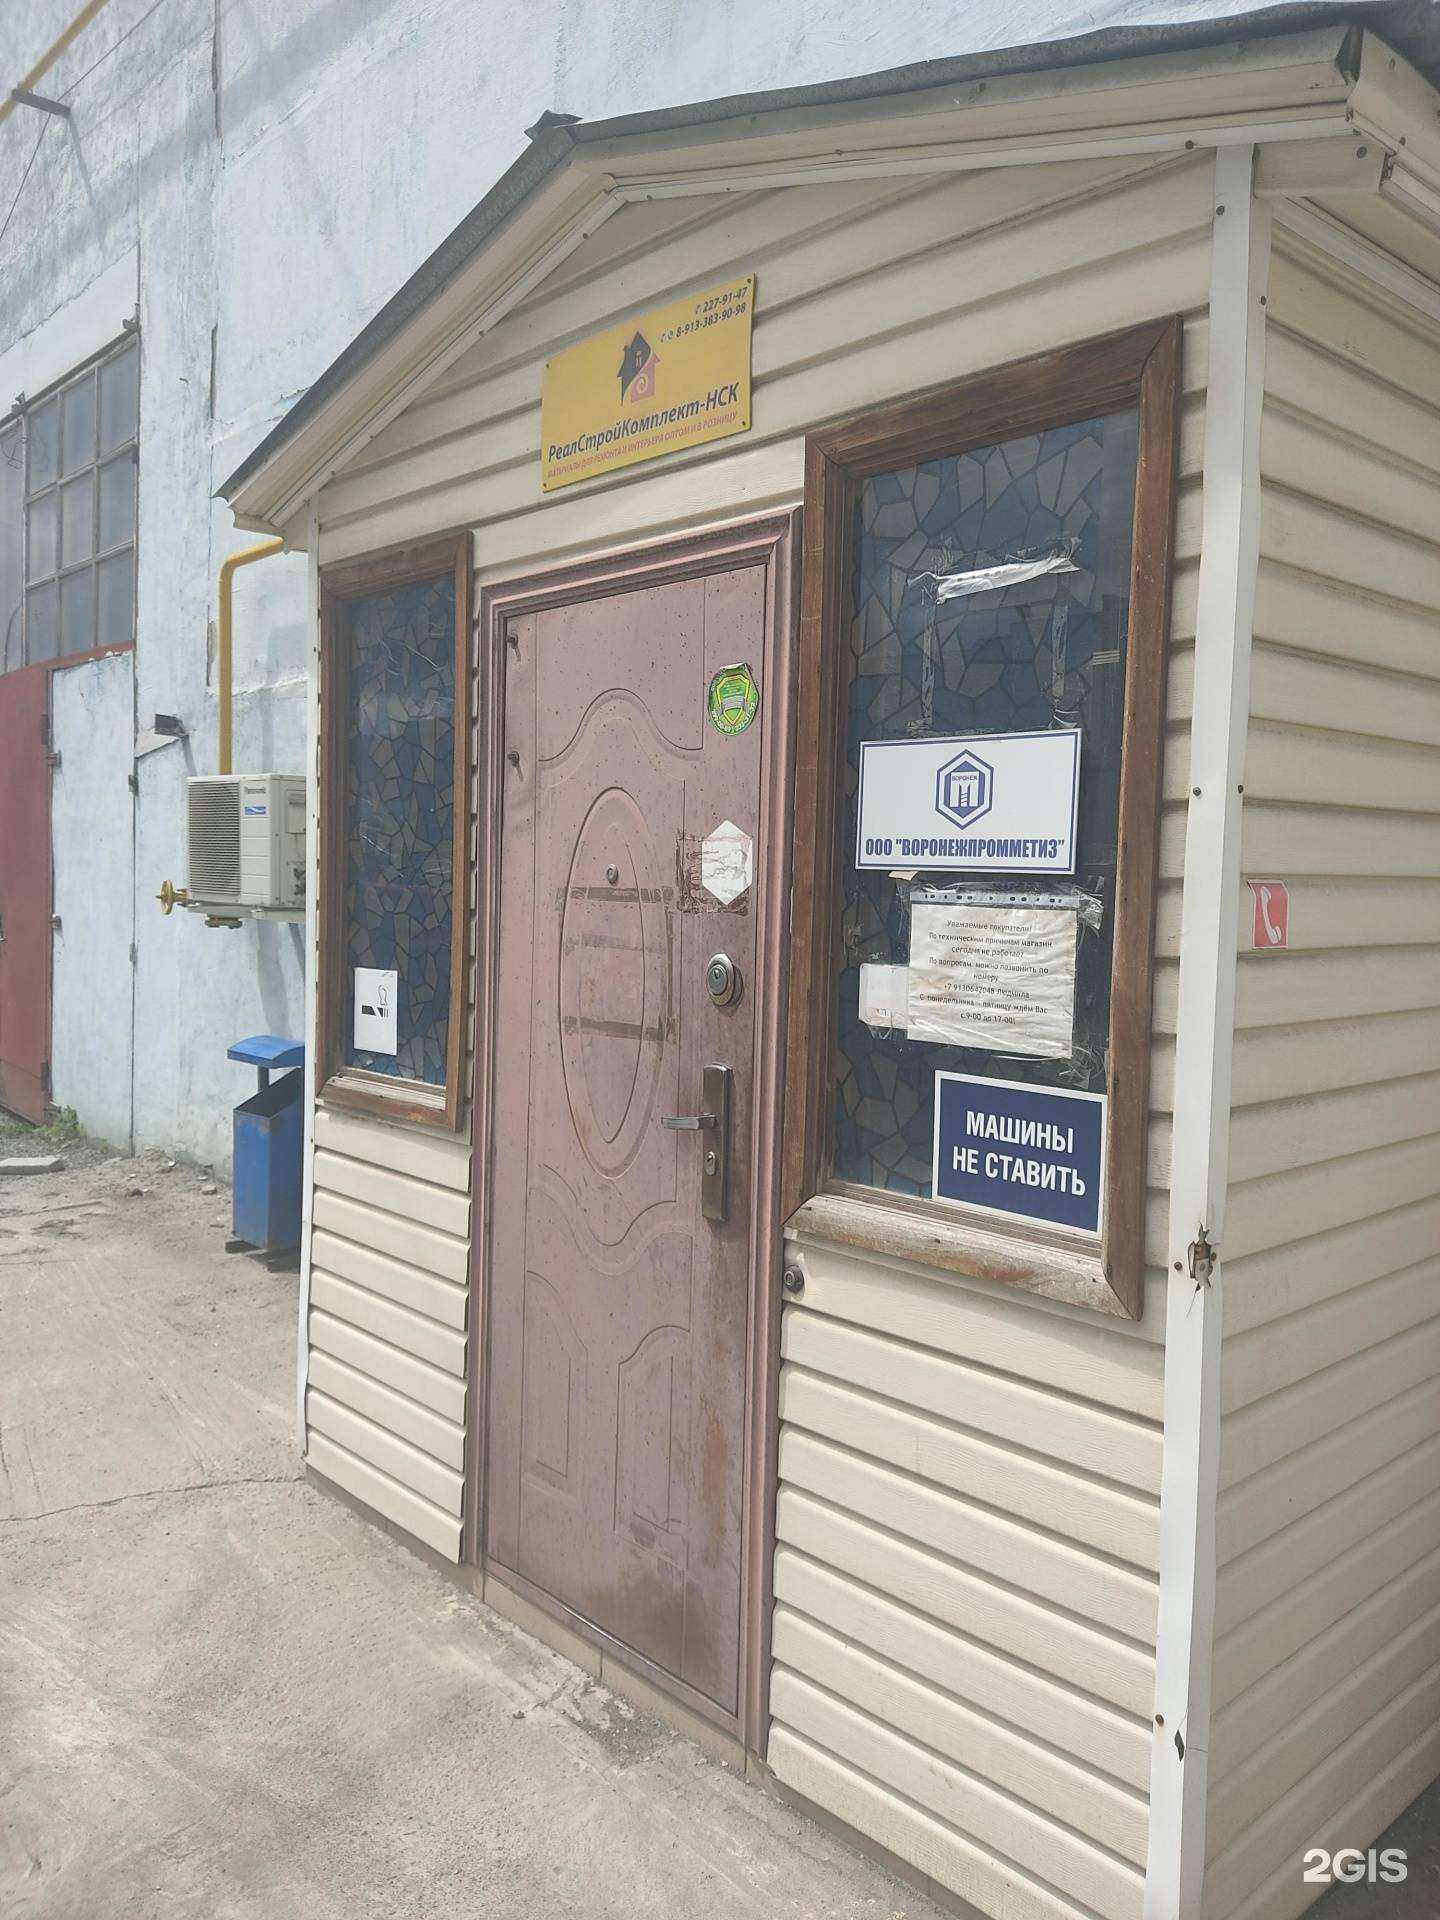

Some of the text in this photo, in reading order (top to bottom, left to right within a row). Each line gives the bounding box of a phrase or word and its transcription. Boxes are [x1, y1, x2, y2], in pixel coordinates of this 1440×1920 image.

[702, 286, 748, 313] 227-91-47
[548, 382, 740, 463] РеалСтройКомплект-НСК
[664, 425, 688, 439] ОПТОМ
[702, 411, 737, 430] РОЗНИЦУ
[865, 838, 892, 856] ООО
[946, 919, 988, 930] Уважаемые
[929, 932, 937, 940] По
[938, 934, 984, 944] техническим
[1021, 939, 1053, 948] магазин
[951, 946, 981, 955] сегодня
[981, 948, 990, 956] не
[929, 957, 937, 965] По
[975, 962, 998, 970] можно
[999, 964, 1037, 973] позвонить
[1038, 967, 1049, 975] по
[927, 995, 975, 1007] понедельника
[982, 1001, 1012, 1011] пятницу
[1035, 1005, 1048, 1014] Вас
[983, 1015, 992, 1023] до
[966, 1110, 1074, 1154] МАШИНЫ
[952, 1145, 1086, 1196] НЕ СТАВИТЬ
